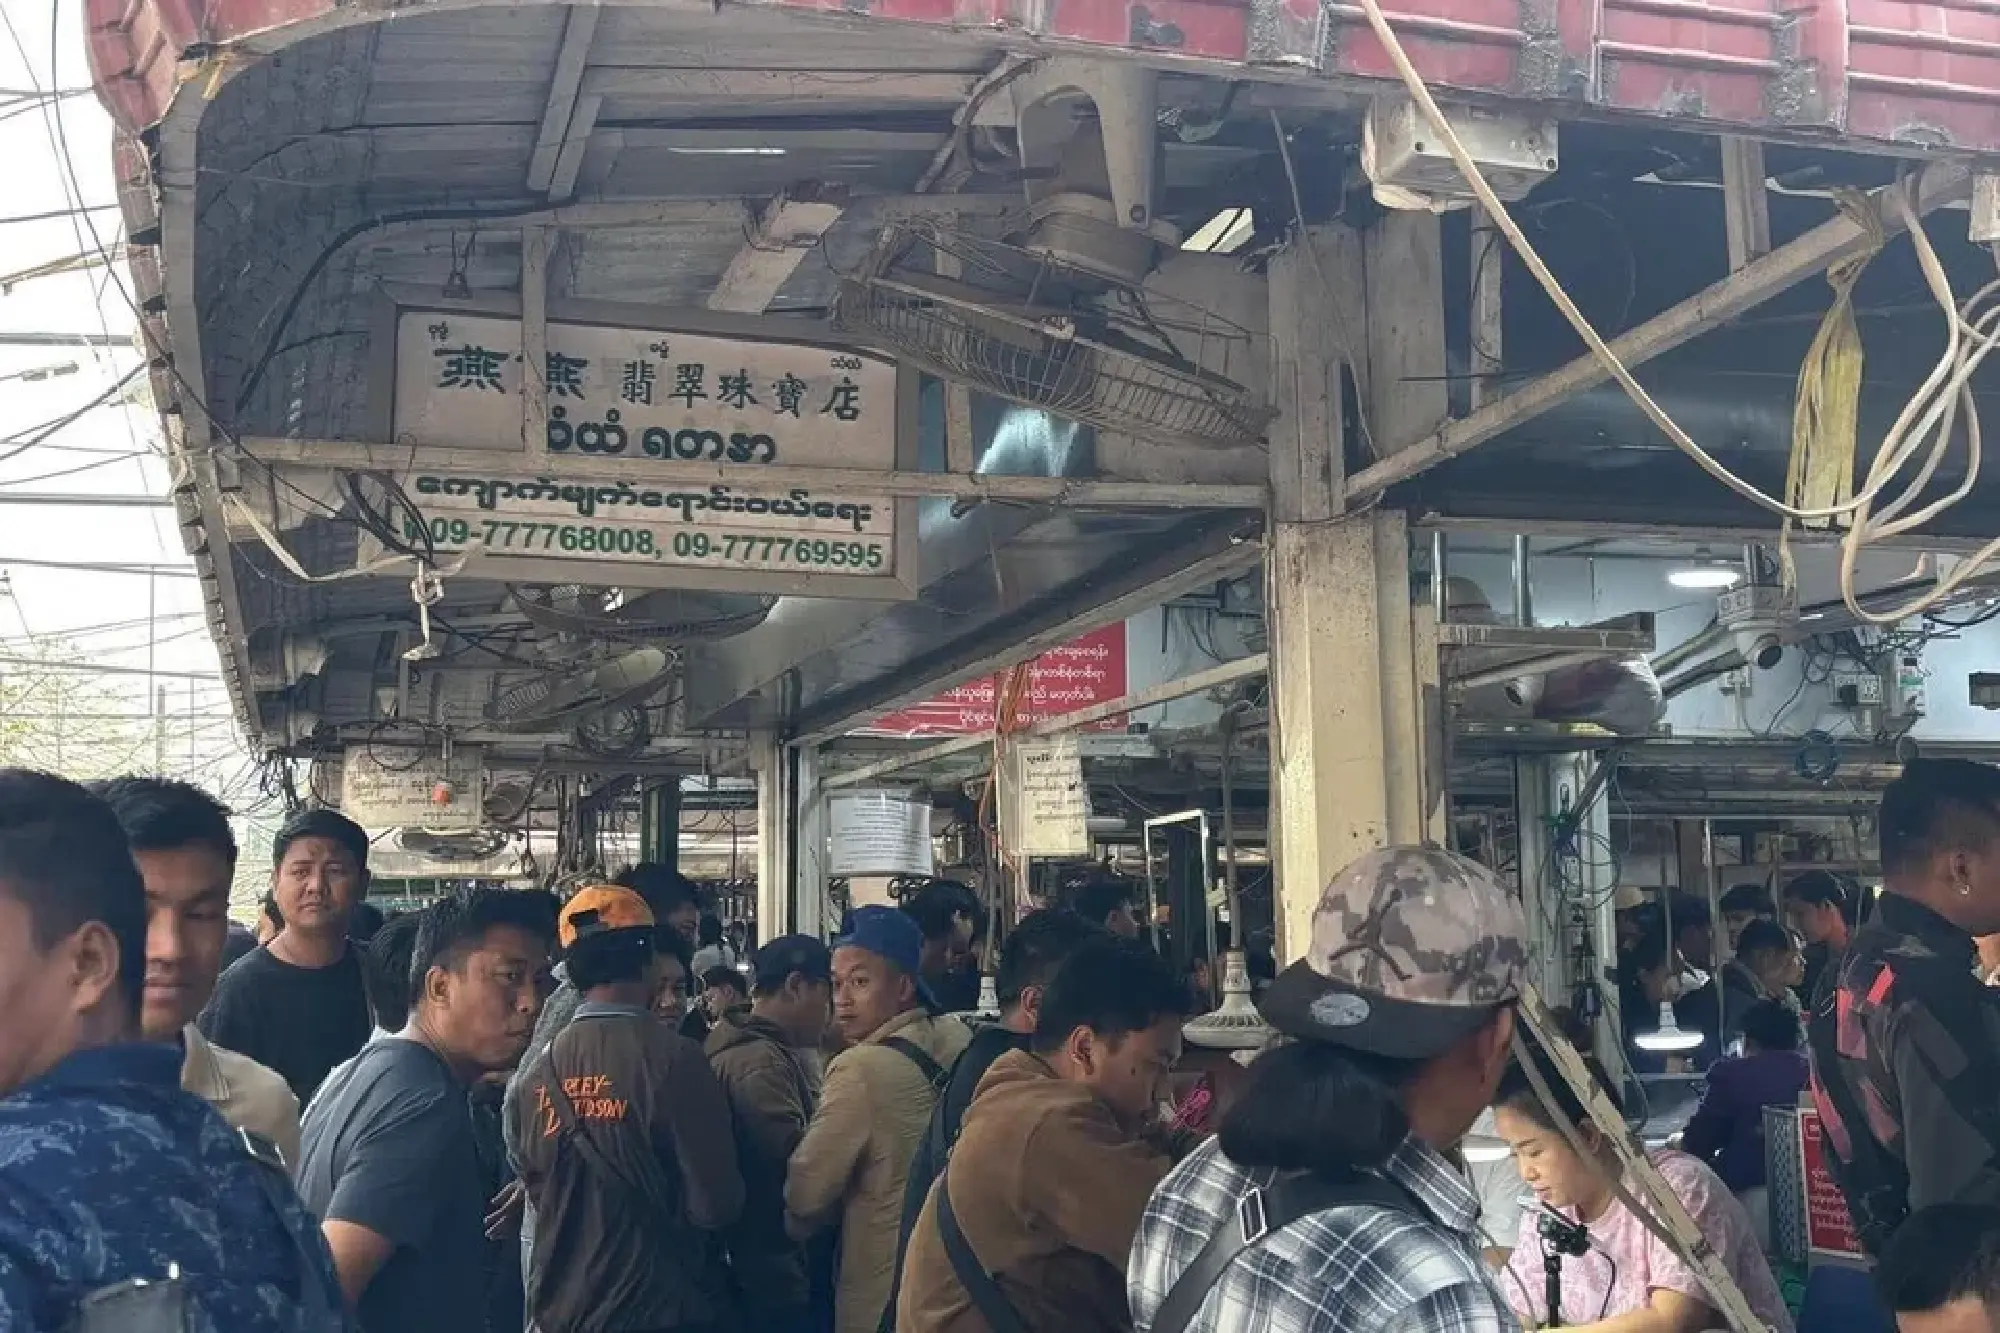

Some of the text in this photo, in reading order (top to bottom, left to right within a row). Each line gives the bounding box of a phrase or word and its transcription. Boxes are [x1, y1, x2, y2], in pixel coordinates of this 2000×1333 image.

[621, 360, 860, 421] 翡翠珠寶店
[431, 517, 662, 560] 09-777768008,
[673, 532, 883, 568] 09-777769595
